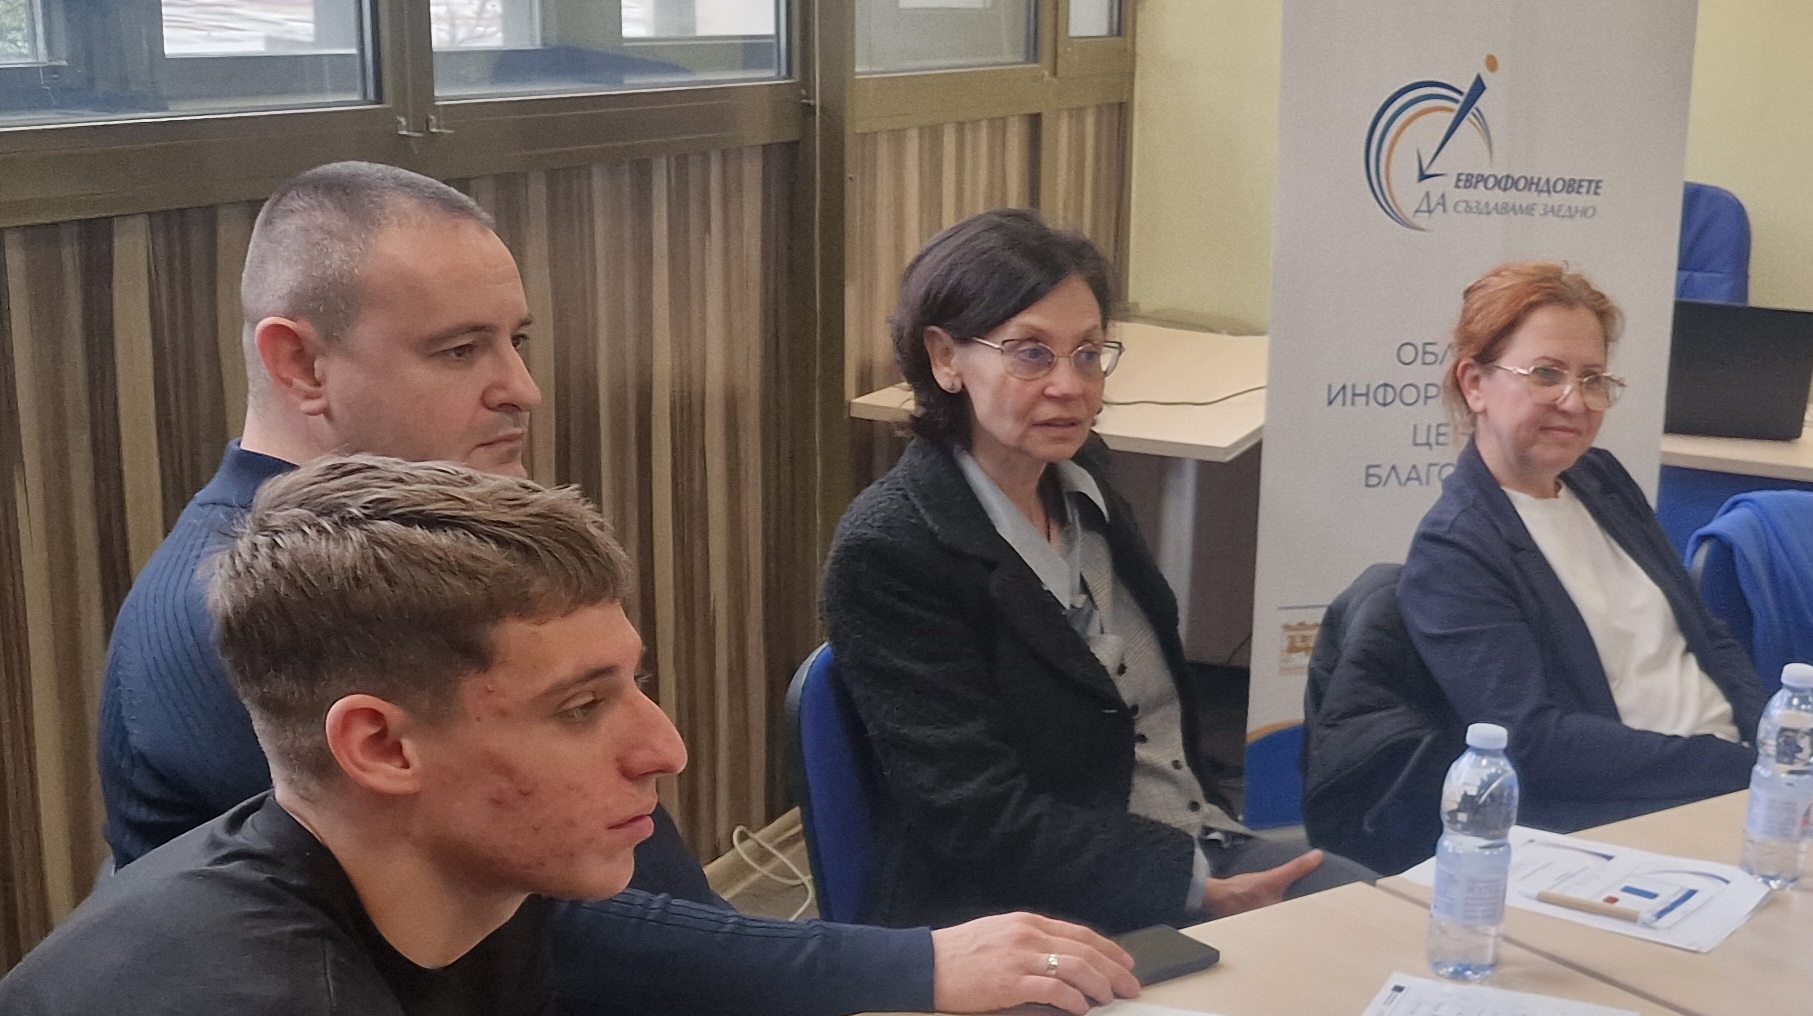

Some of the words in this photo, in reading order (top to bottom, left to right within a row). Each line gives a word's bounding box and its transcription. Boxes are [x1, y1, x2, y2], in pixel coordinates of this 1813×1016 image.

[1453, 172, 1604, 197] ЕВРОФОНДОВЕТЕ
[1413, 190, 1447, 218] ДА
[1452, 199, 1537, 217] СЪЗДАВАМЕ
[1538, 202, 1597, 219] ЗАЕДНО
[1396, 341, 1452, 366] ОБЛ
[1326, 382, 1442, 408] ИНФОР
[1411, 423, 1452, 450] ЦЕ
[1364, 463, 1456, 488] БЛАГО
